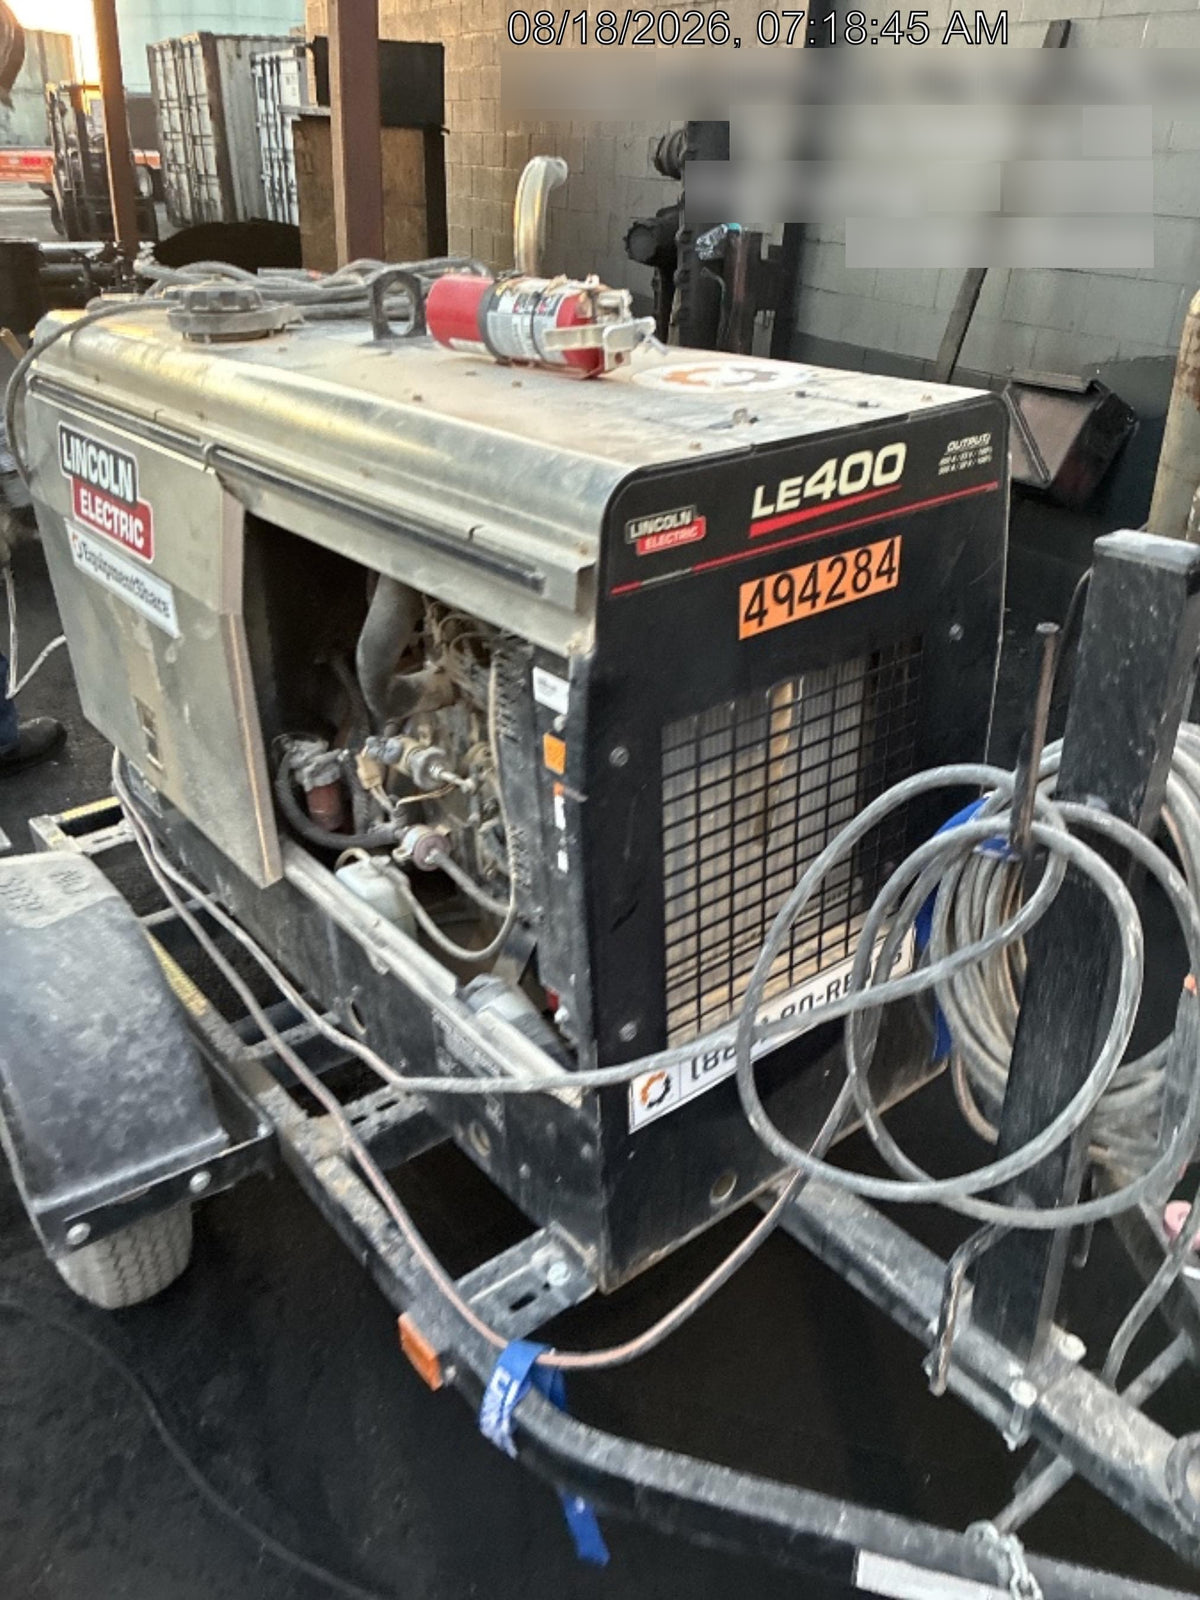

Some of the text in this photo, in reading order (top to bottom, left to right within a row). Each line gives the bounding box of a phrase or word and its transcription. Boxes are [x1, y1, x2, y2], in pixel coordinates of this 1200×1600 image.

[62, 431, 134, 503] LINCOLN
[751, 442, 907, 519] LE400
[80, 488, 144, 550] ELECTRIC
[630, 510, 692, 538] LINCOLN
[644, 525, 700, 550] ELECTRIC
[743, 539, 897, 627] 494284
